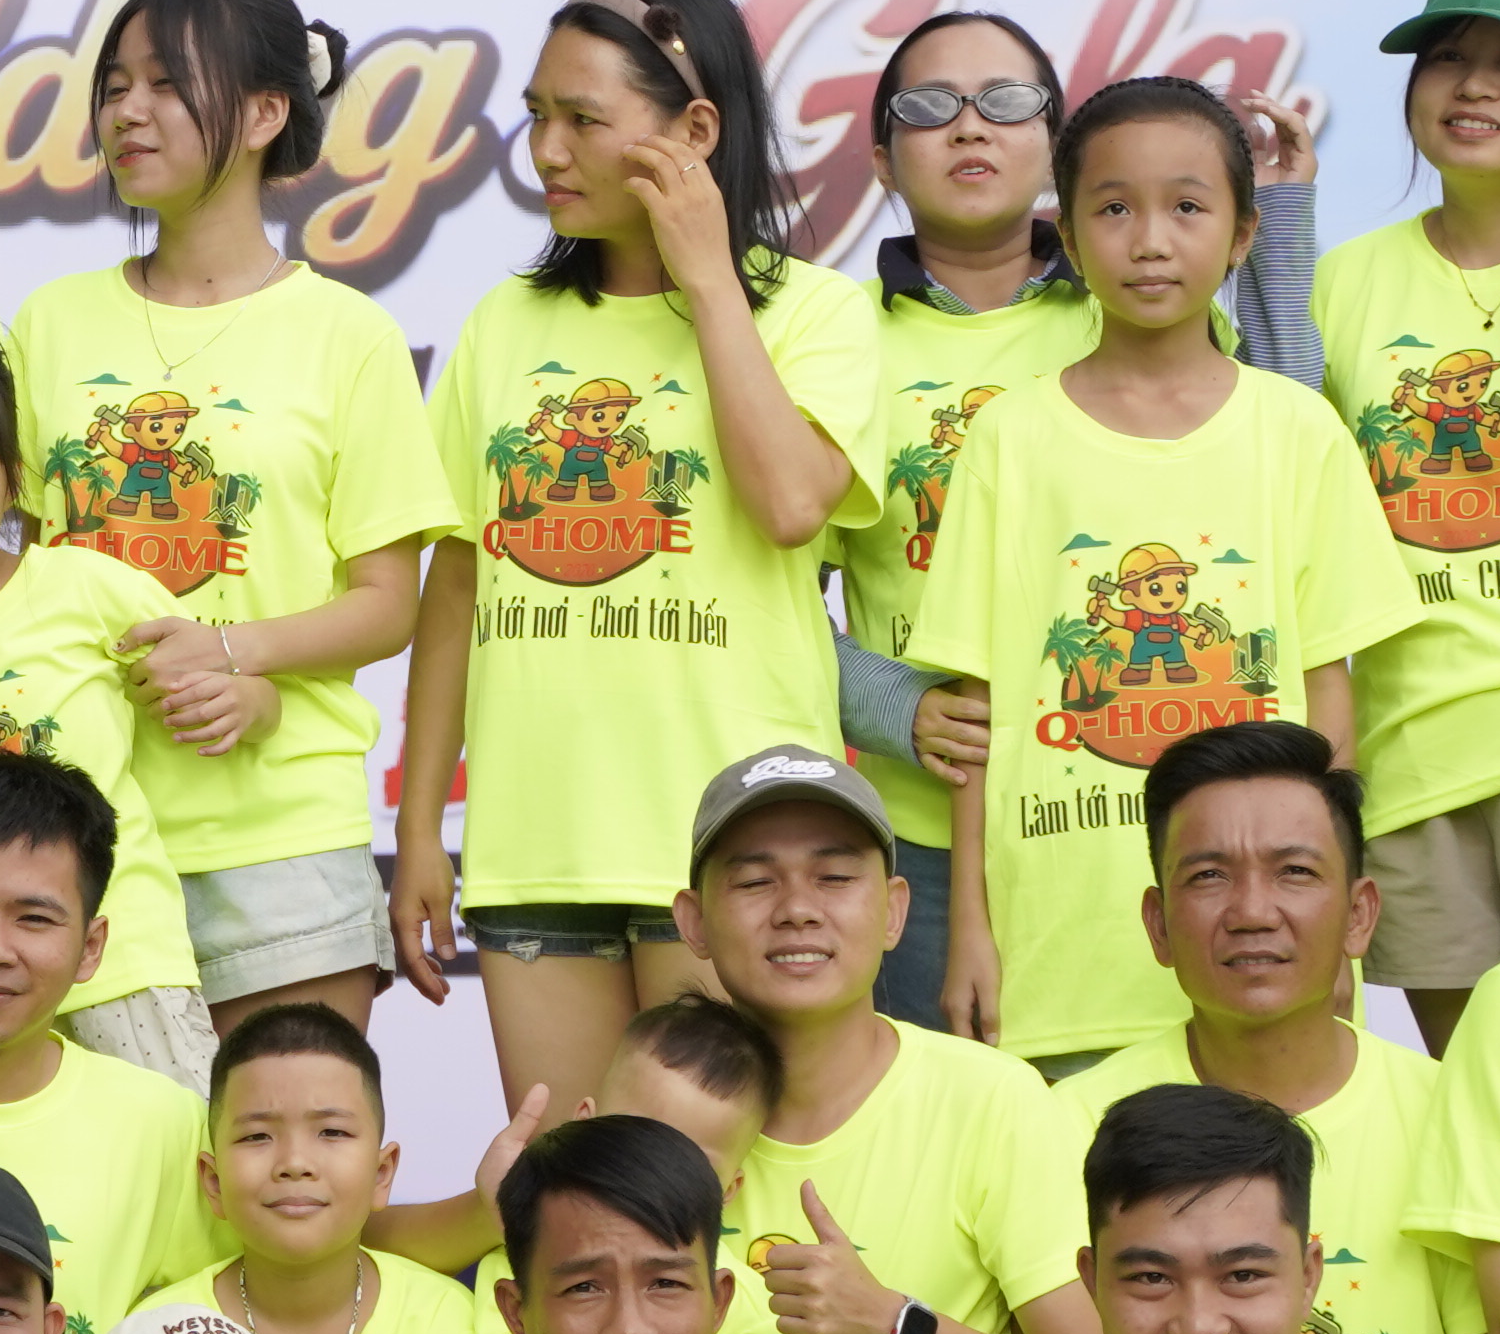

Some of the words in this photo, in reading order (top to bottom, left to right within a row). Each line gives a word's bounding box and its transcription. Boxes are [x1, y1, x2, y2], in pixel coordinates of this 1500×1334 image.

[483, 516, 695, 560] Q-HOME
[1416, 563, 1456, 605] nơi
[496, 596, 526, 639] tới
[532, 596, 569, 639] nơi
[590, 595, 639, 639] Chơi
[649, 598, 680, 643] tới
[688, 598, 727, 648] bến
[1020, 793, 1069, 839] Làm
[1076, 784, 1109, 830] tới
